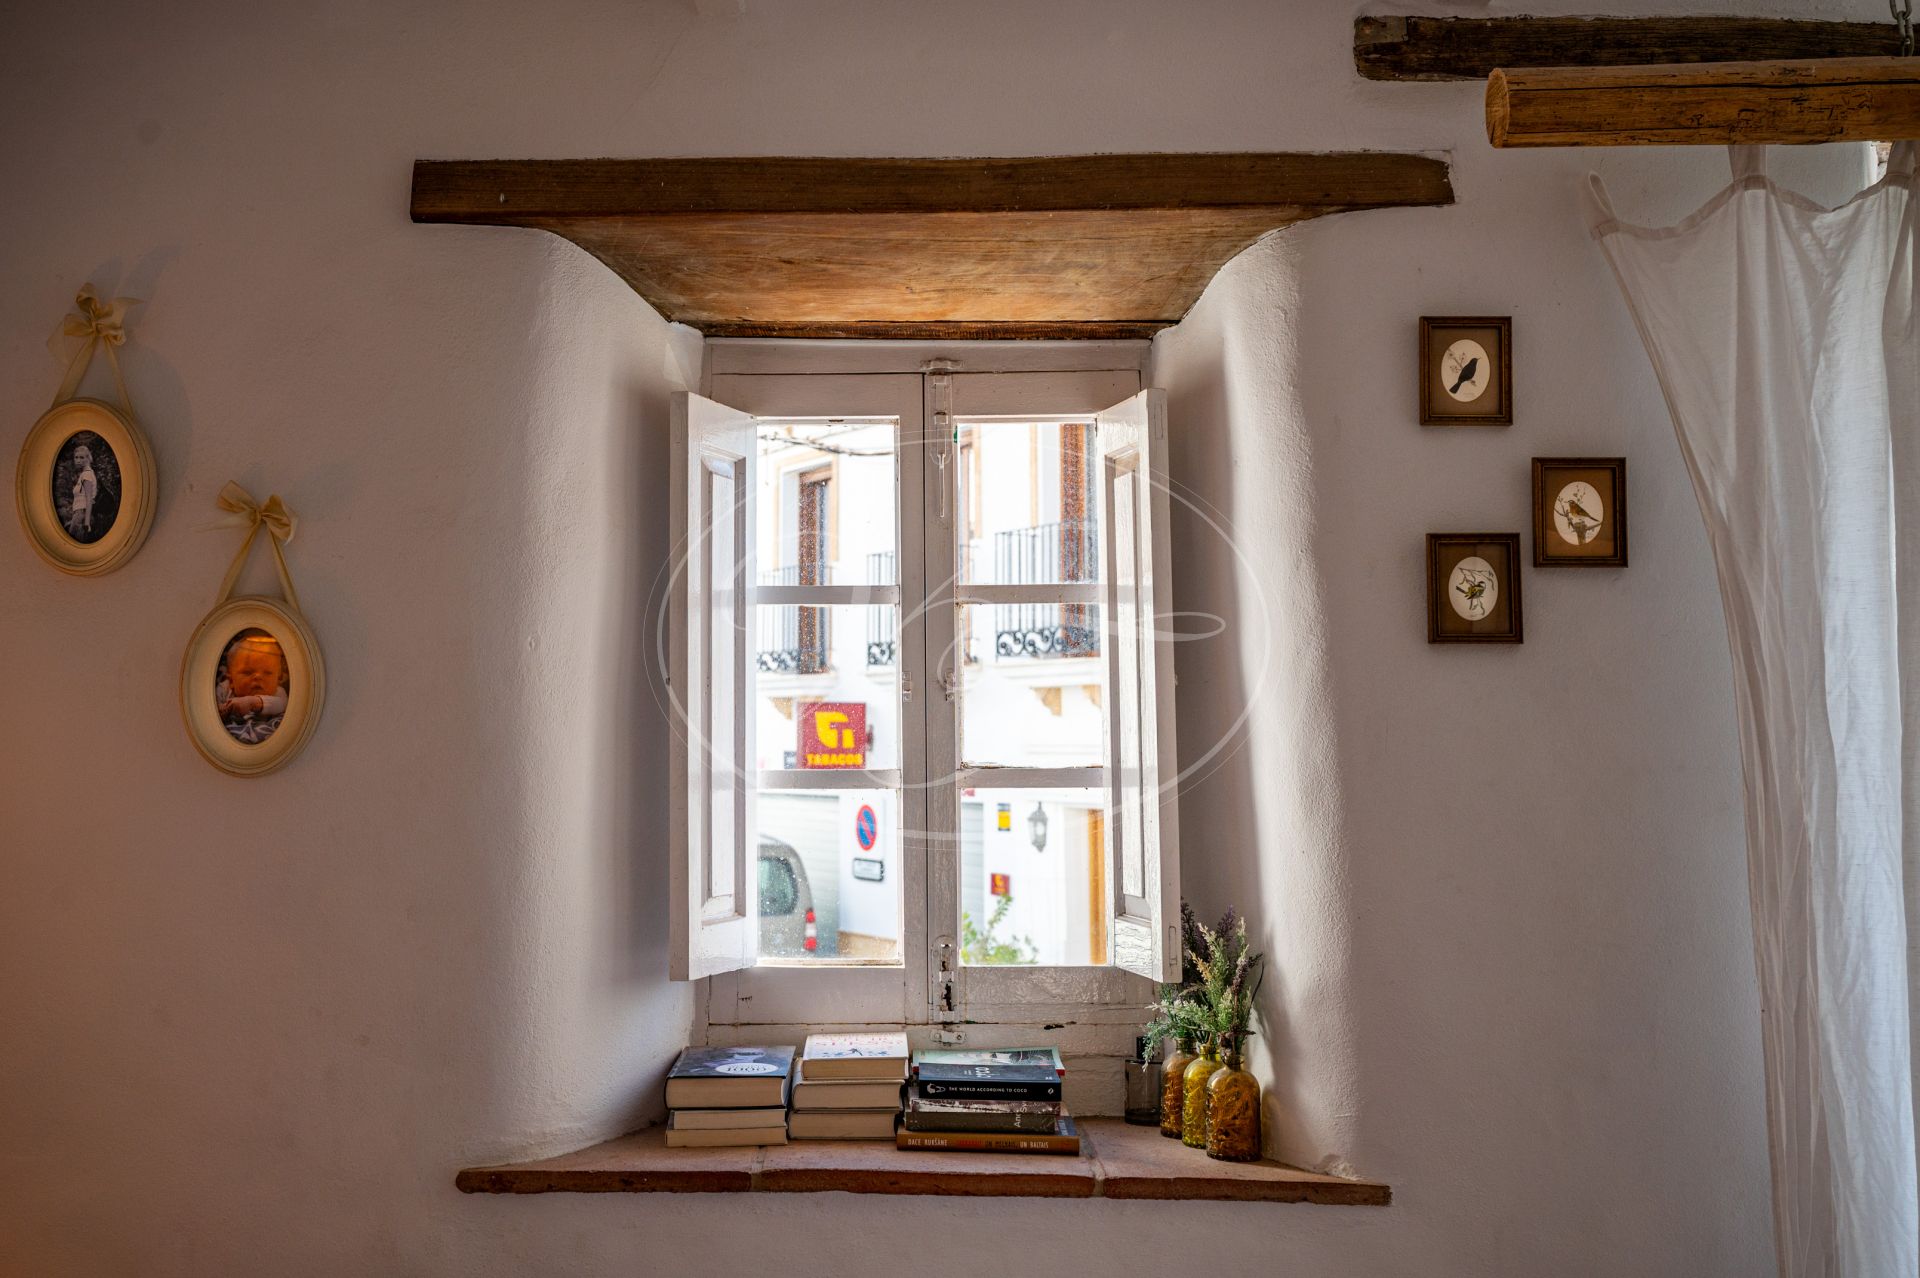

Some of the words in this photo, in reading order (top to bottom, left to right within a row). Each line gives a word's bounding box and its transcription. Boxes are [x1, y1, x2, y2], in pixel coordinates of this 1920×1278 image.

[805, 753, 863, 766] TABACOS
[907, 1138, 921, 1146] DACE
[1030, 1141, 1049, 1149] BALTAIS
